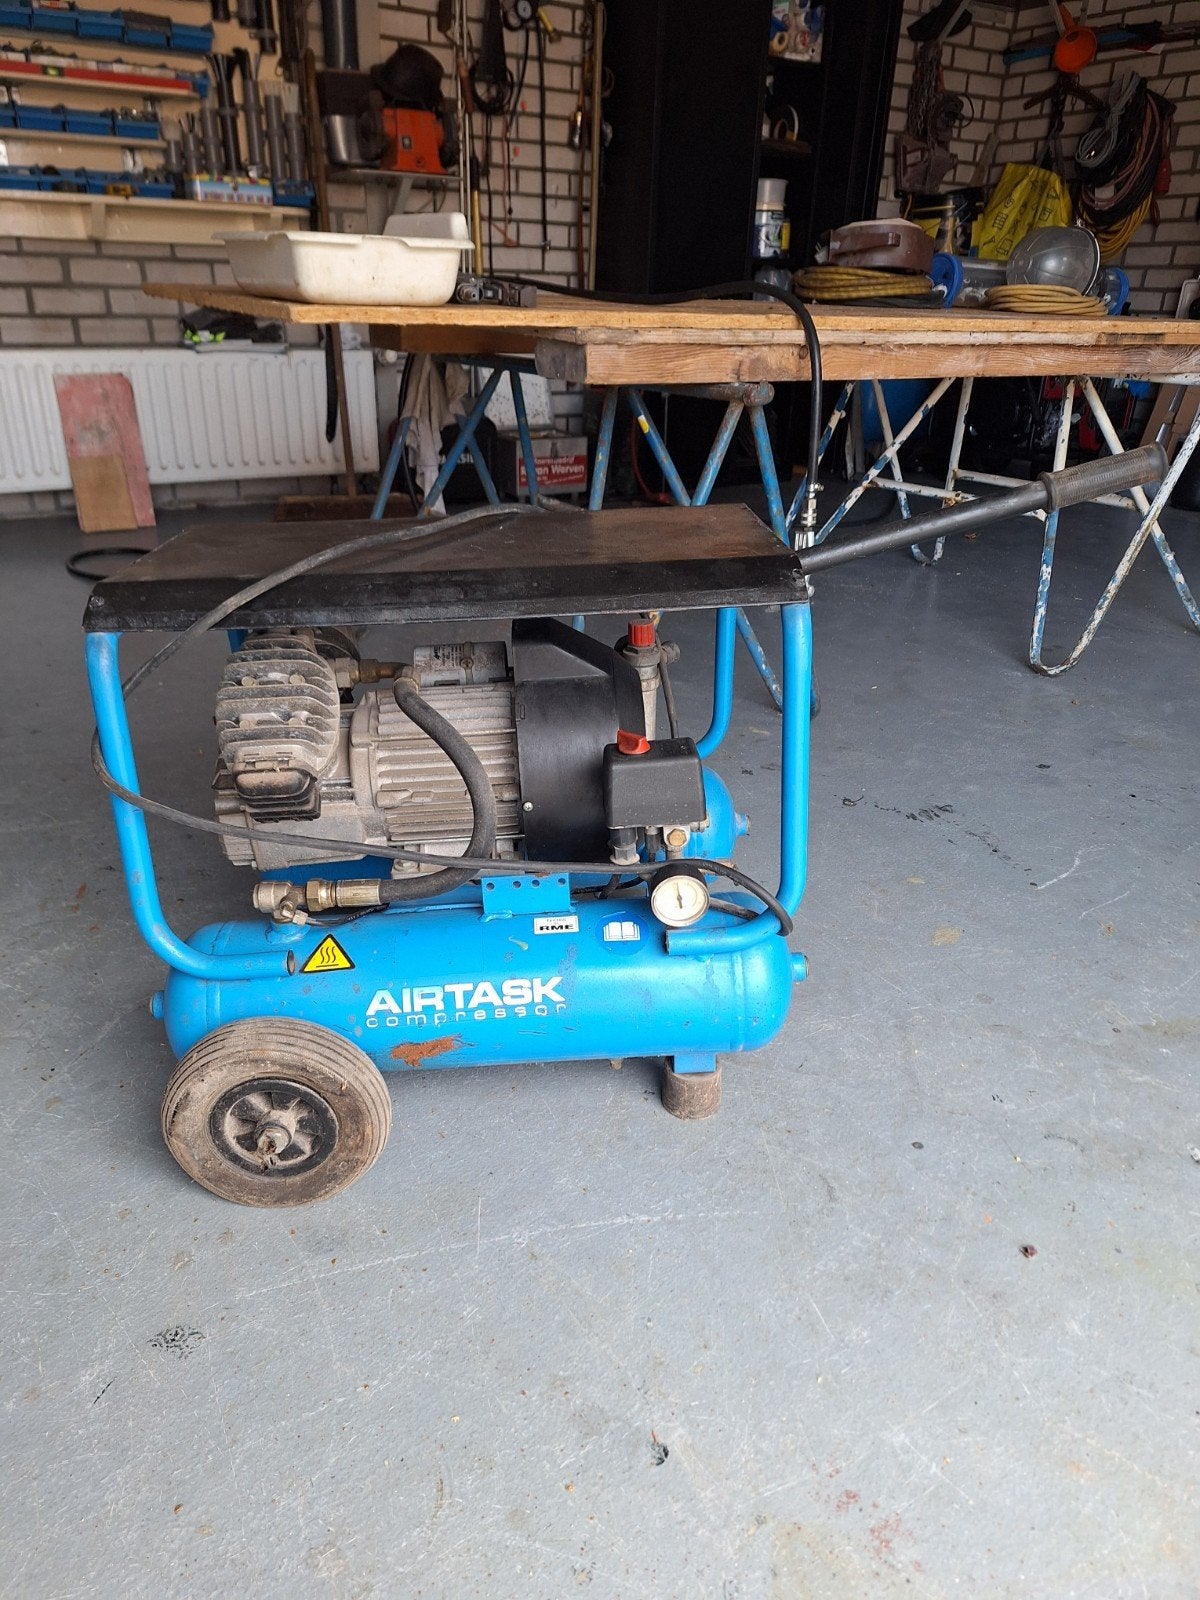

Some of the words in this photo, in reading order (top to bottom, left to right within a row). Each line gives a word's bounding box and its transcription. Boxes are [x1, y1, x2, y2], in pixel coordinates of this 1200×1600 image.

[539, 923, 574, 931] RME
[365, 976, 566, 1016] AIRTASK
[365, 1003, 567, 1029] compressor
